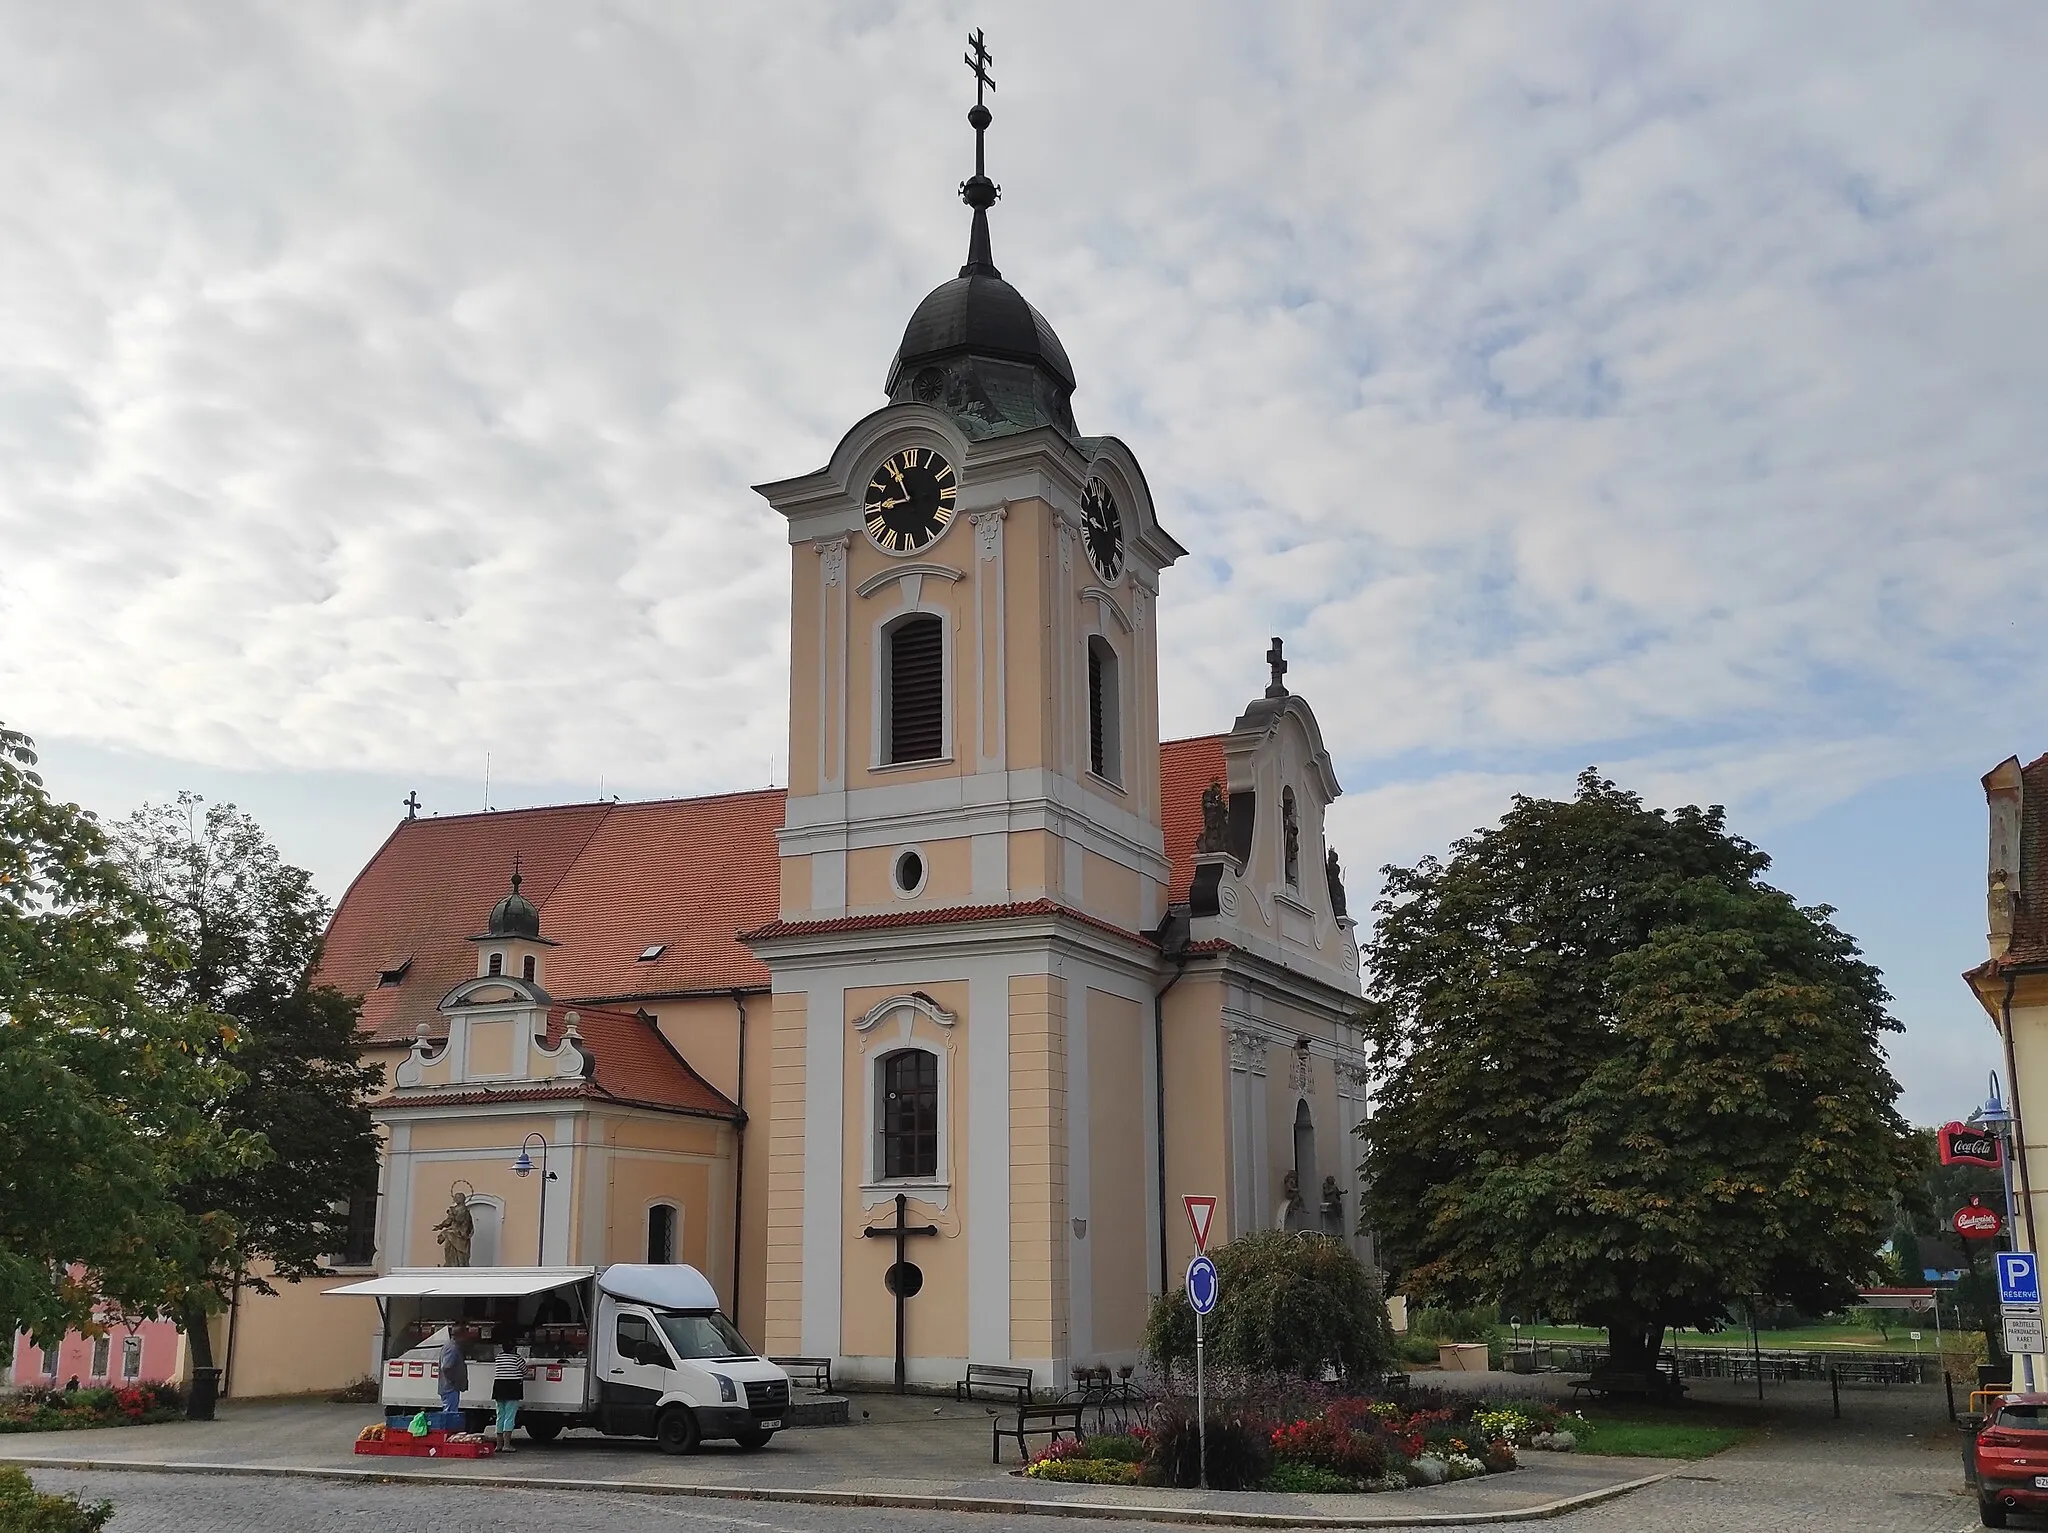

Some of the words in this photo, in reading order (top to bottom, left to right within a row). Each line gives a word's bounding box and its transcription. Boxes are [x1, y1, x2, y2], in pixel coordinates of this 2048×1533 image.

[902, 449, 919, 469] XII
[923, 451, 935, 469] I
[934, 464, 952, 482] II
[869, 479, 887, 493] X
[940, 485, 957, 500] III
[864, 501, 882, 515] IX
[933, 506, 953, 525] IIII
[867, 515, 886, 540] VIII
[924, 525, 937, 541] V
[881, 528, 898, 550] VII
[904, 533, 916, 551] VI
[2007, 1259, 2030, 1288] P
